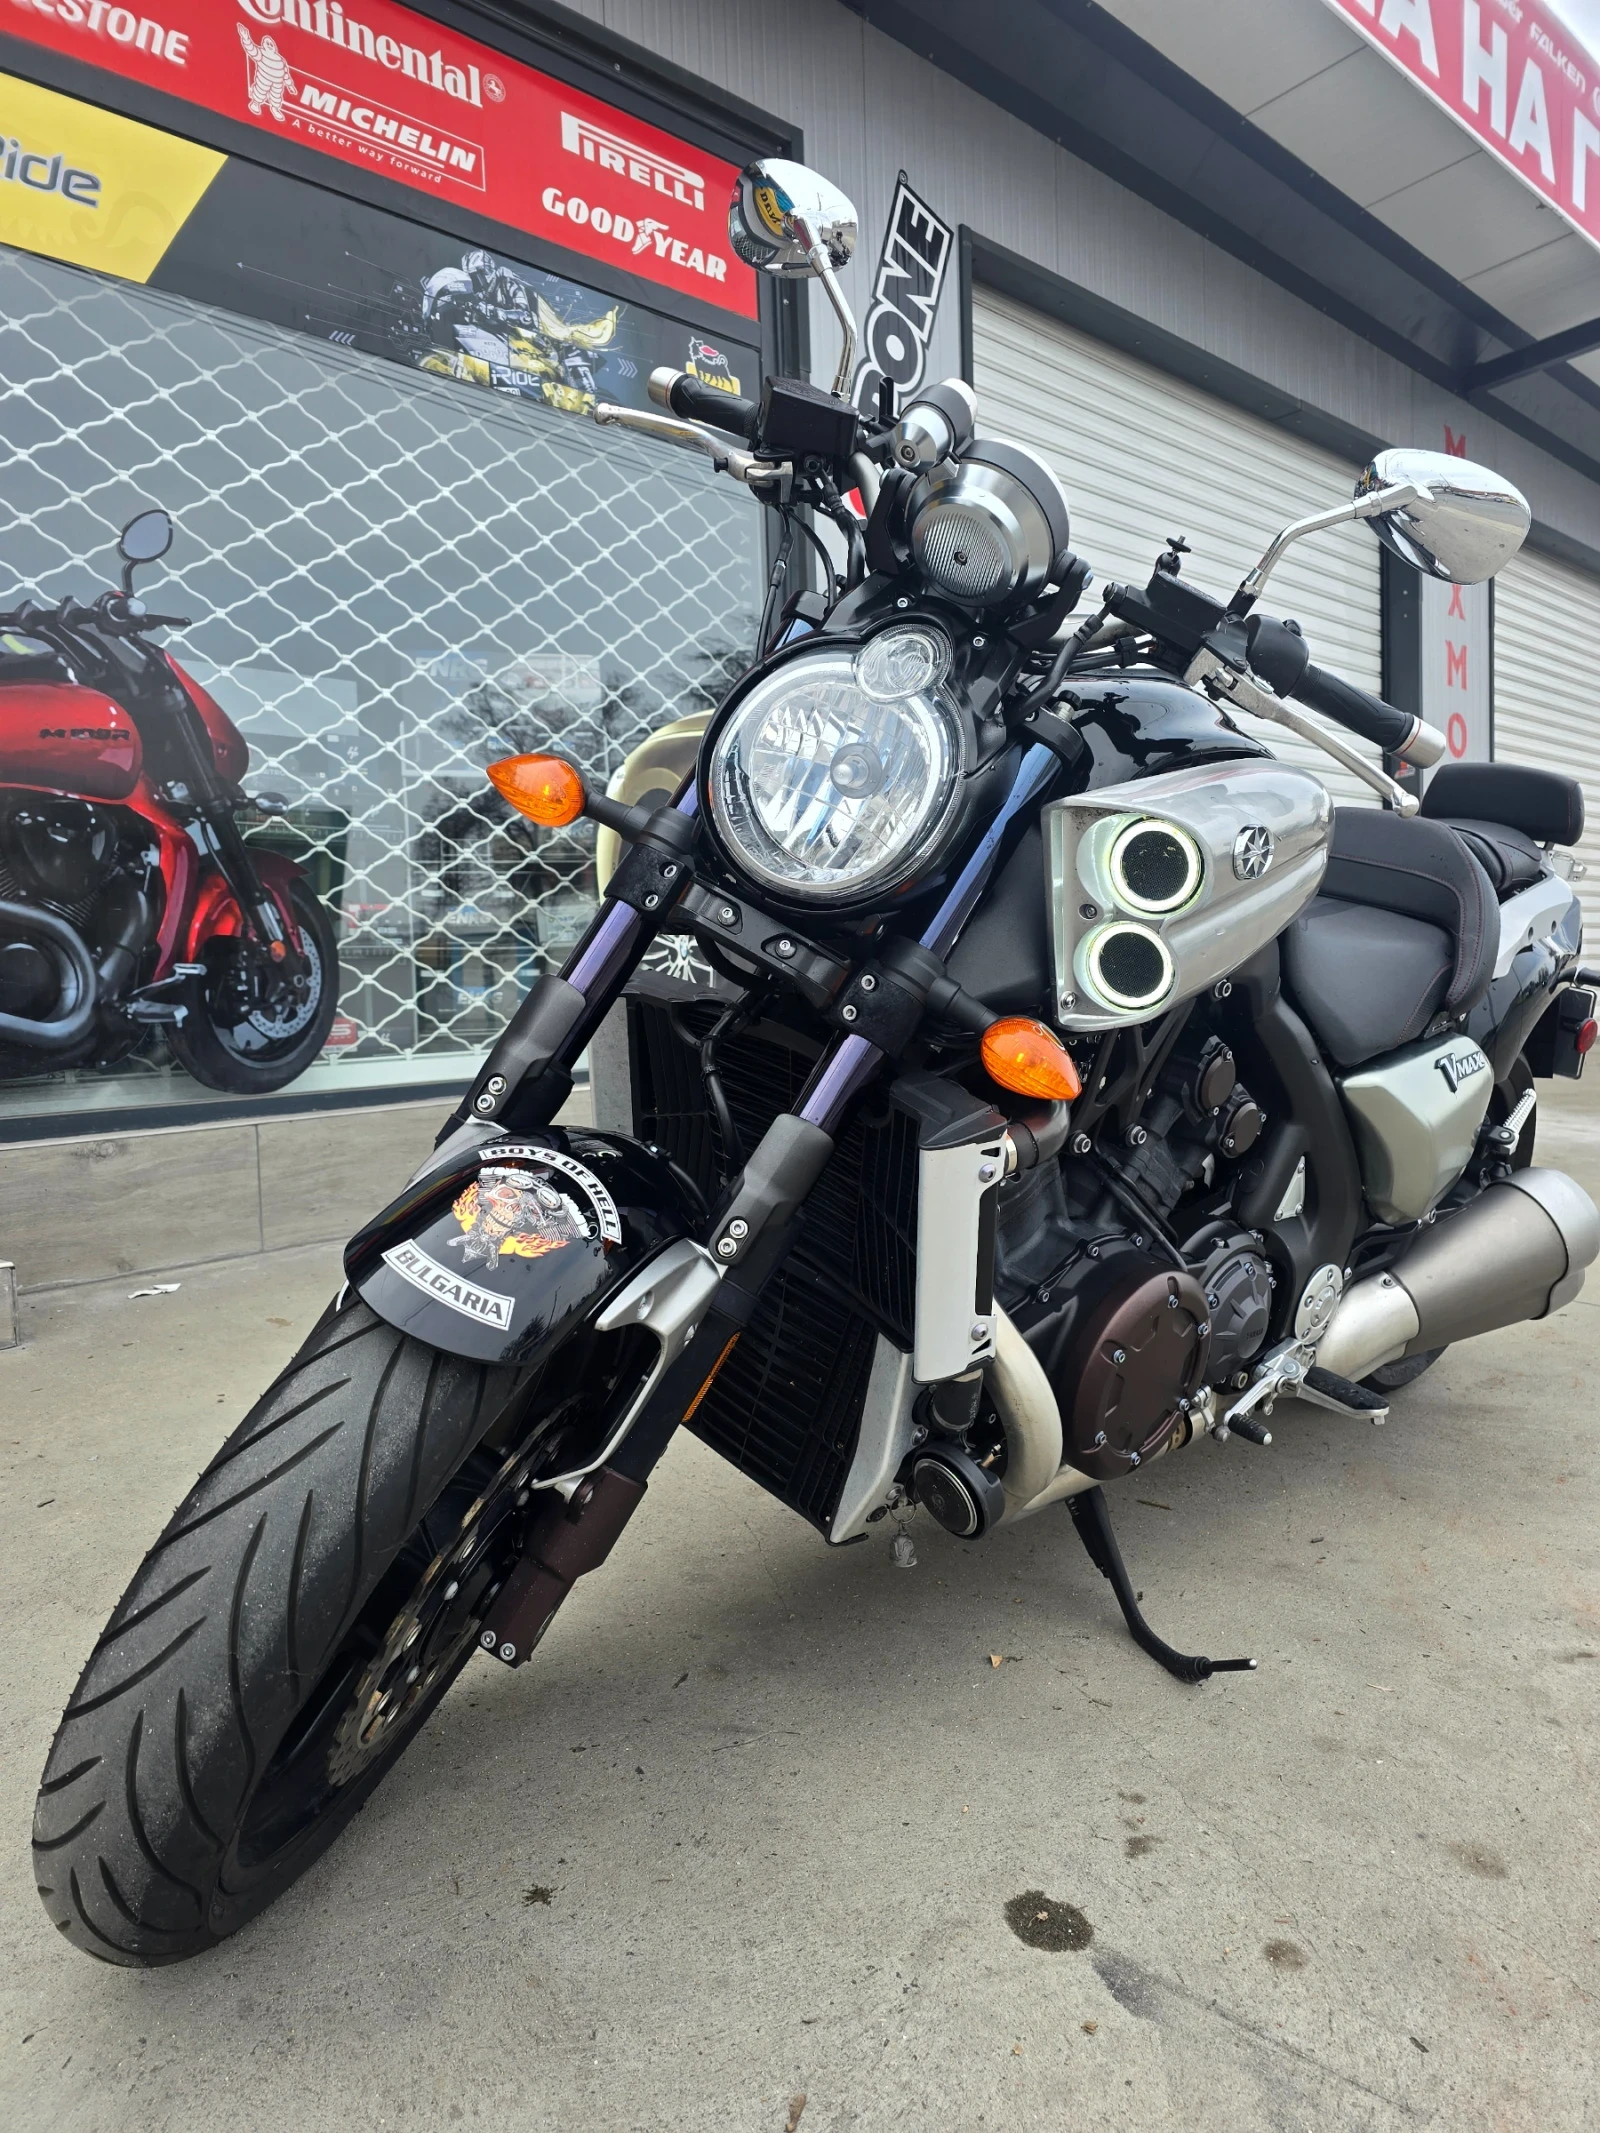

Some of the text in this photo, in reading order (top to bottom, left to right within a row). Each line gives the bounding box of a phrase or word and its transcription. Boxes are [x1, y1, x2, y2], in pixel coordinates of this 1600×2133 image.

[1530, 21, 1586, 94] FALKEN
[292, 118, 442, 183] A better way forward
[300, 84, 476, 172] MICHELIN
[561, 111, 705, 211] PIRELLI
[0, 135, 101, 208] ide
[491, 1147, 617, 1232] BOYS OF HELL
[395, 1249, 503, 1321] BULGARIA
